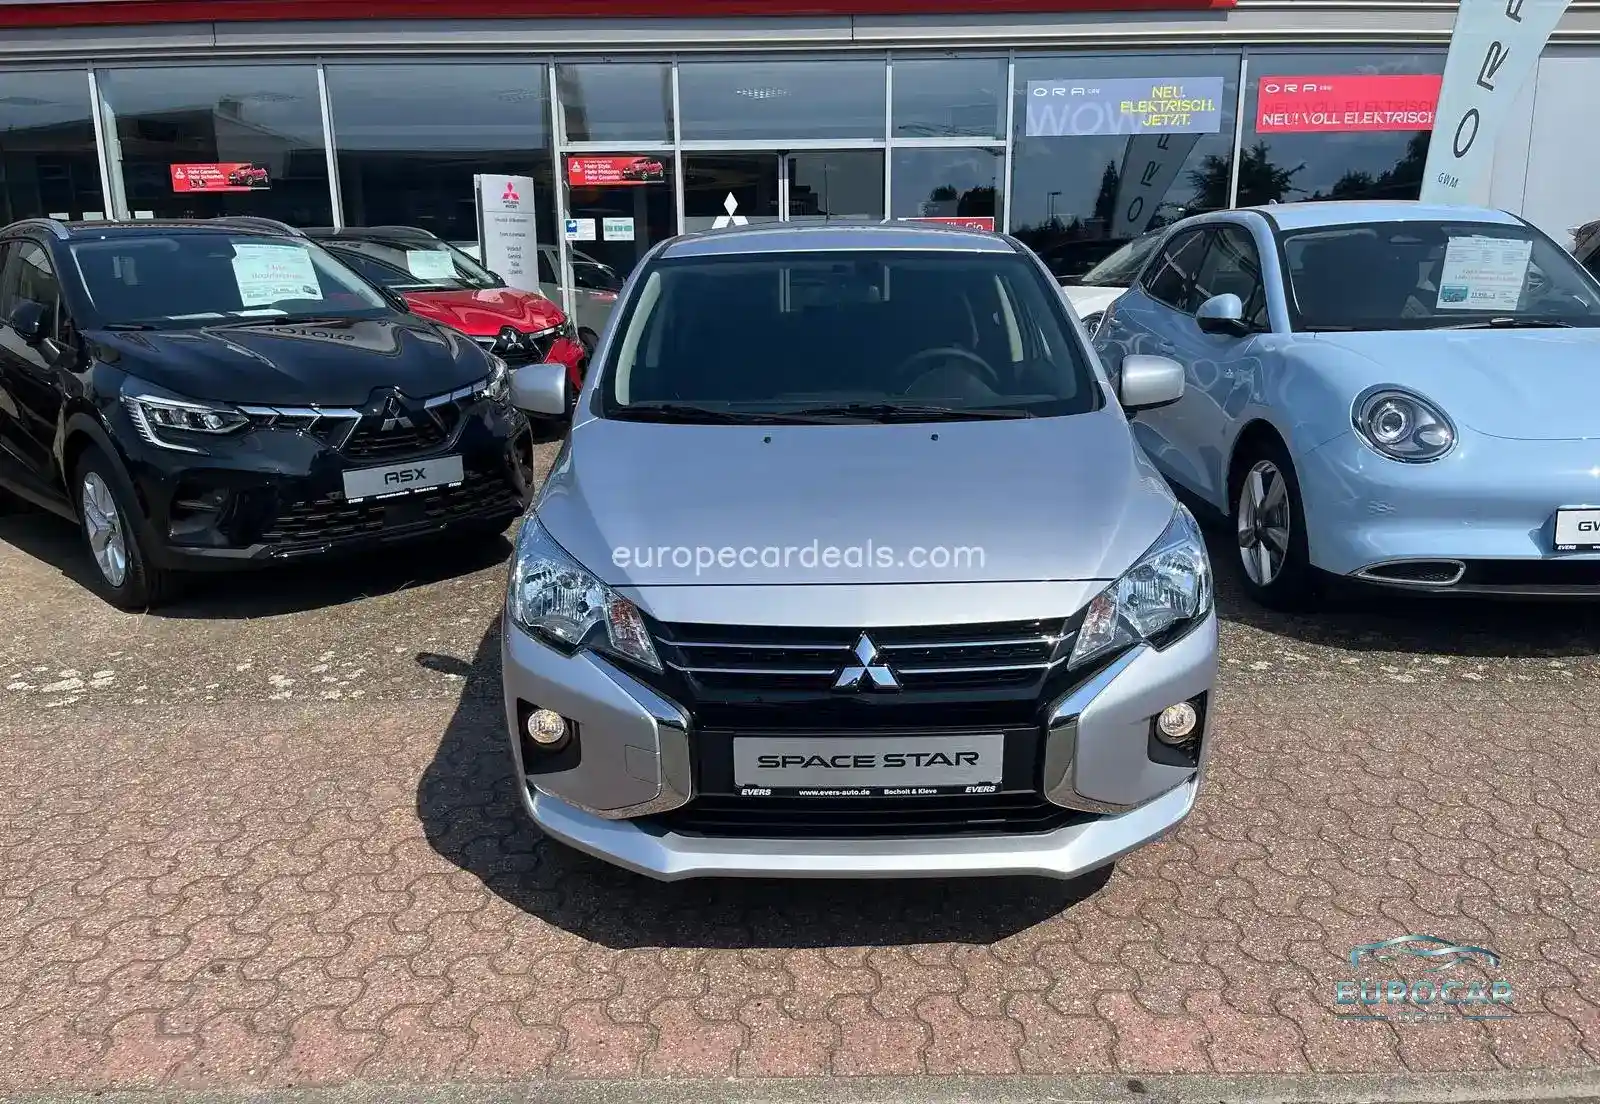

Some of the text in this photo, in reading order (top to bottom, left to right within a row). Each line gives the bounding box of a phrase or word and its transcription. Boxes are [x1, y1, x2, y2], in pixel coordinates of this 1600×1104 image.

[1033, 87, 1085, 97] ORA
[1151, 86, 1186, 99] NEU.
[1265, 83, 1317, 94] ORA
[1120, 99, 1215, 113] ELEKTRISCH.
[1142, 113, 1191, 127] JETZT.
[1262, 112, 1298, 126] NEU!
[1302, 112, 1340, 125] VOLL
[1438, 172, 1459, 188] GWM
[384, 467, 427, 485] ASX
[757, 751, 980, 769] SPACE STAR
[741, 788, 772, 796] EVERS
[798, 788, 871, 796] www.evers-auto.de
[883, 788, 912, 796] Bocholt
[964, 785, 996, 793] EVERS
